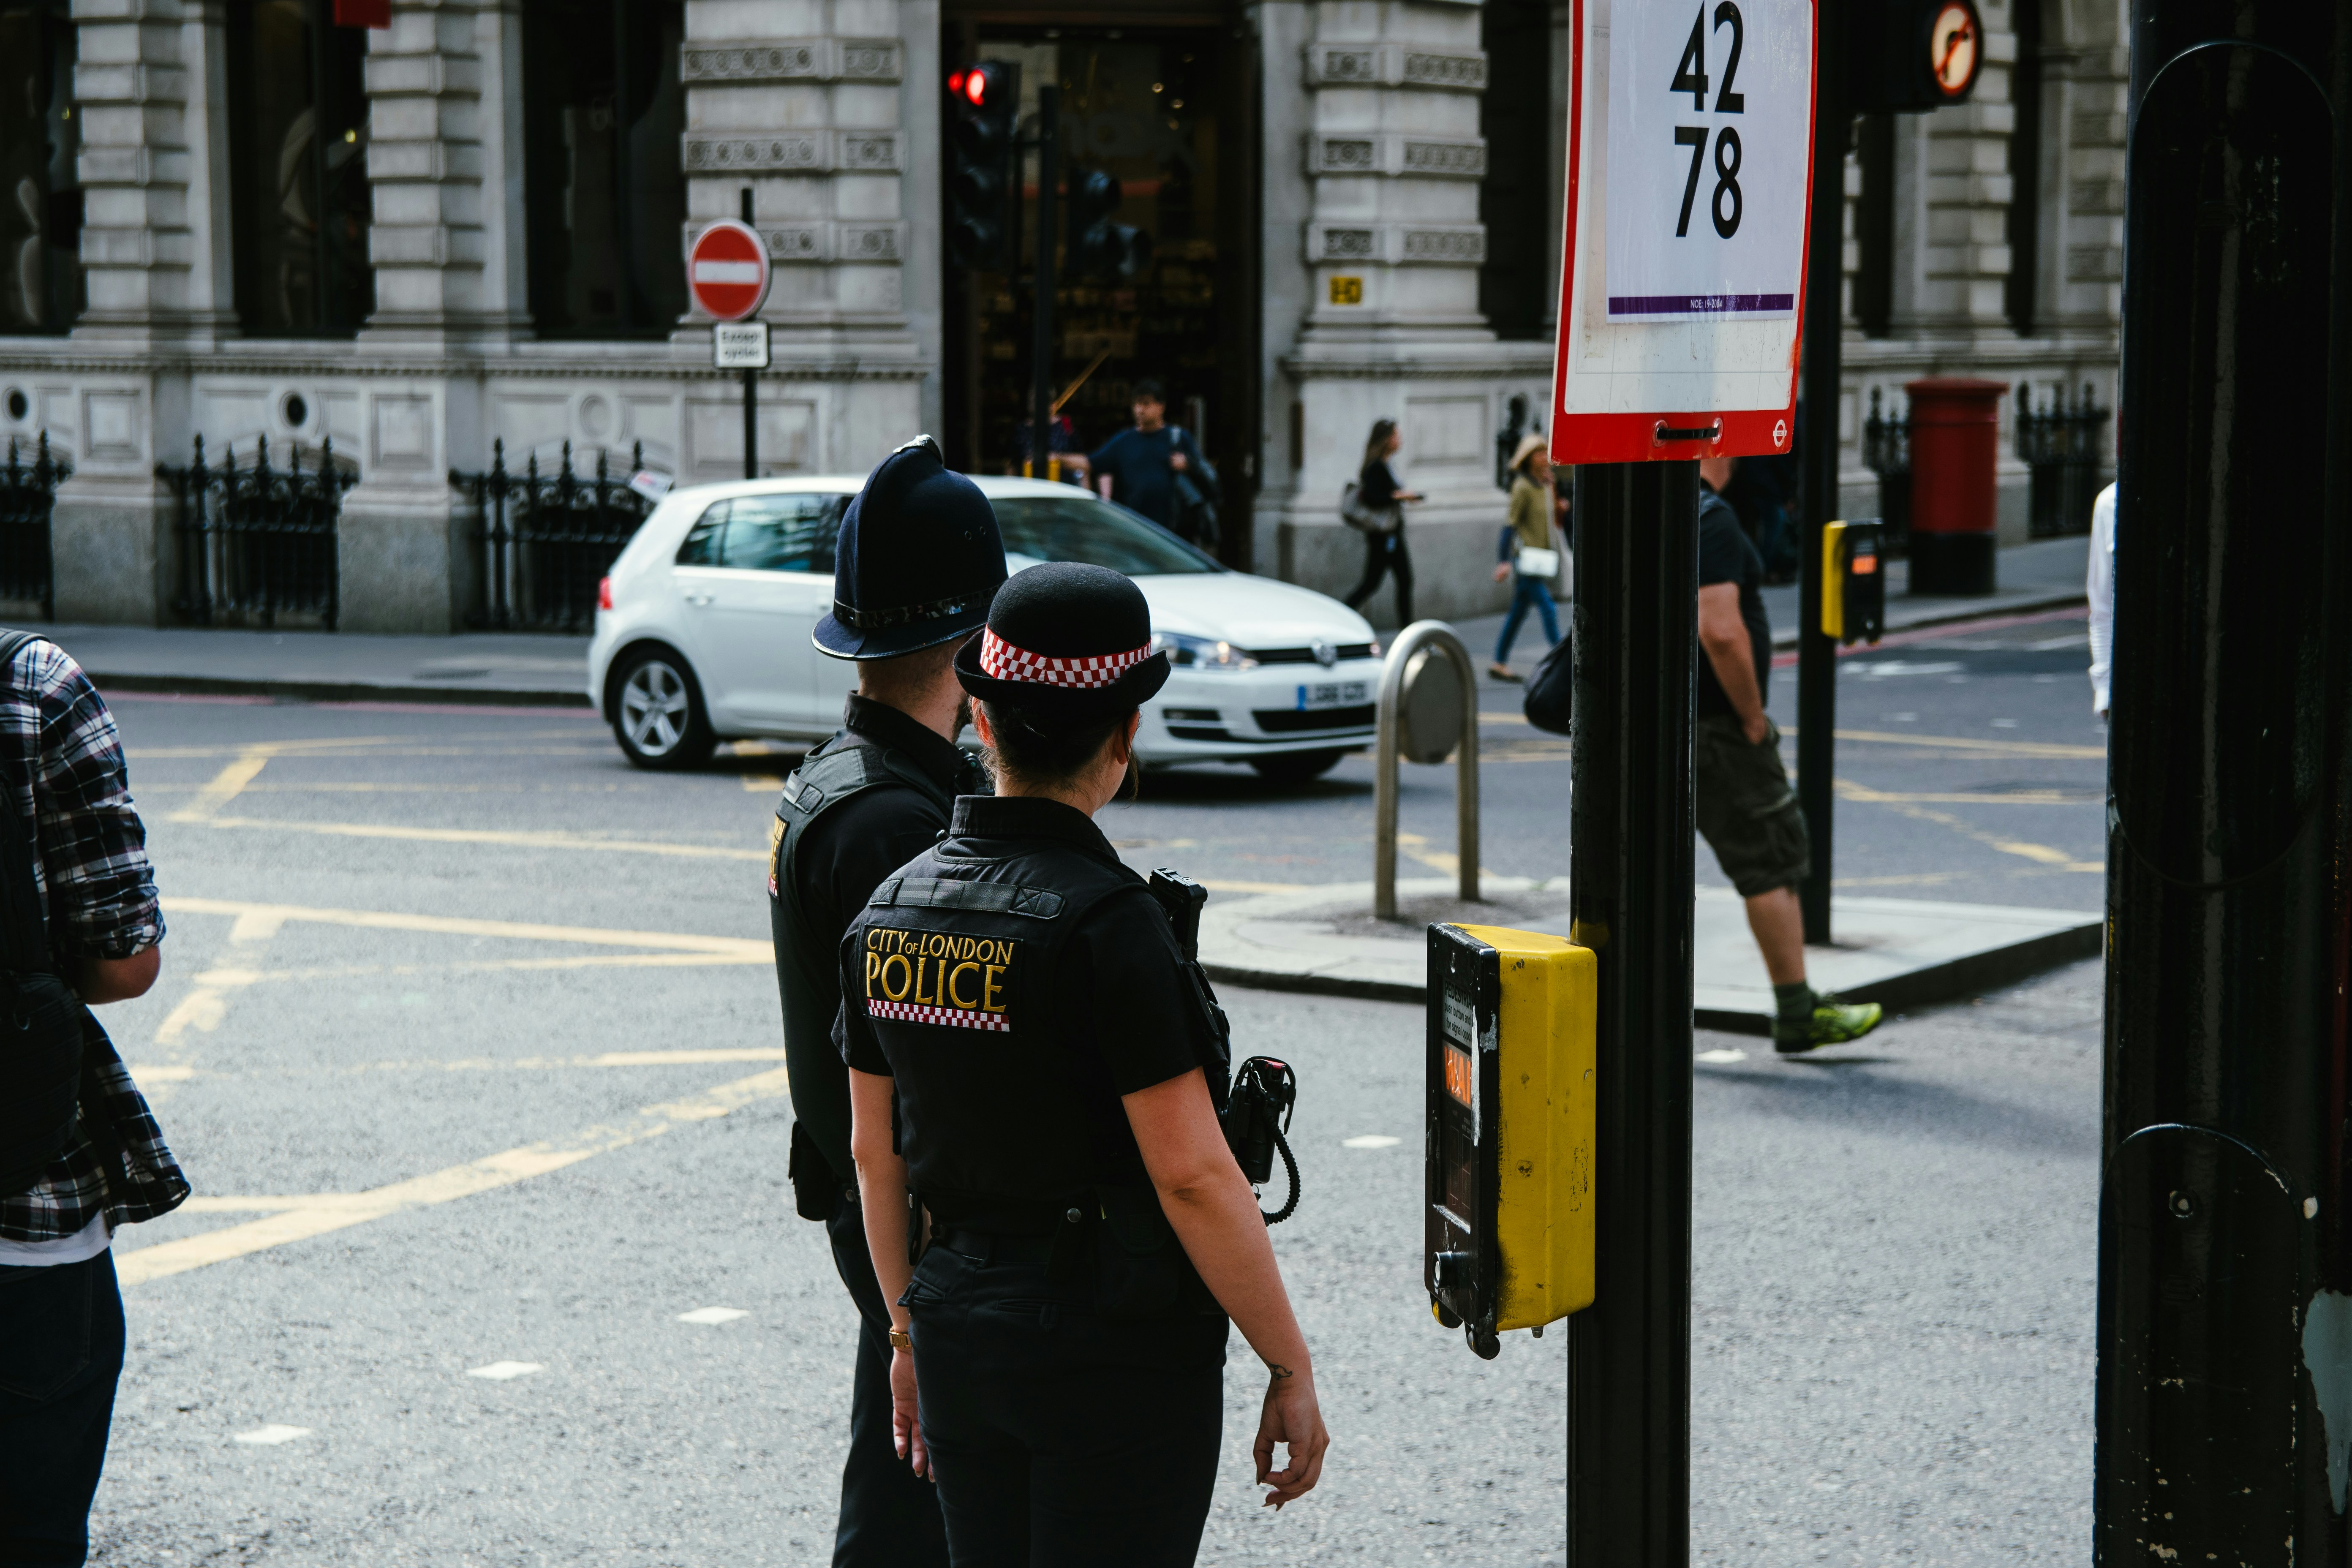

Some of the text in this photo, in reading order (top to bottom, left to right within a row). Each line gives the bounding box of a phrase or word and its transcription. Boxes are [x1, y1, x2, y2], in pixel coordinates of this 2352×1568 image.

[1669, 0, 1744, 114] 42
[1674, 126, 1742, 240] 78
[1690, 299, 1722, 308] NOE: 19-2084
[867, 928, 1014, 965] CITY OF LONDON
[866, 951, 1007, 1013] POLICE
[1445, 980, 1472, 1010] PEDESTRIA
[1444, 1002, 1453, 1015] push
[1453, 1005, 1464, 1022] button
[1452, 1021, 1462, 1036] signal
[1462, 1029, 1472, 1043] oppos
[1444, 1046, 1471, 1105] WAI
